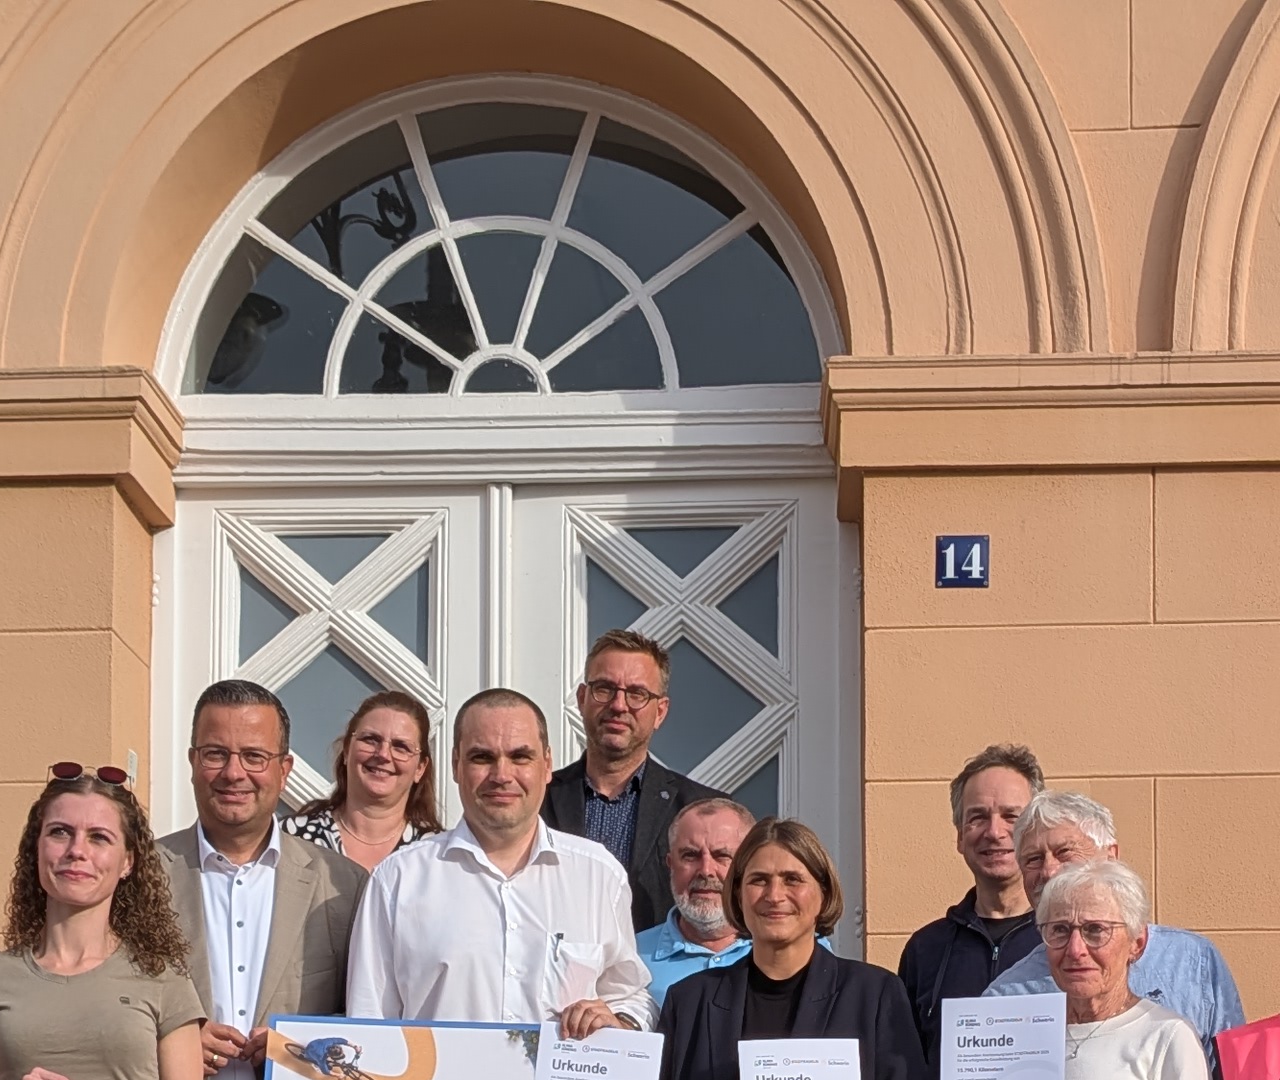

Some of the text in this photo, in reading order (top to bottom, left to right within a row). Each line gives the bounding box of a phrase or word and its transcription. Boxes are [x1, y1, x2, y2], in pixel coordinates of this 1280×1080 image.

[941, 543, 985, 579] 14
[957, 1034, 1014, 1048] Urkunde
[552, 1059, 608, 1075] Urkunde
